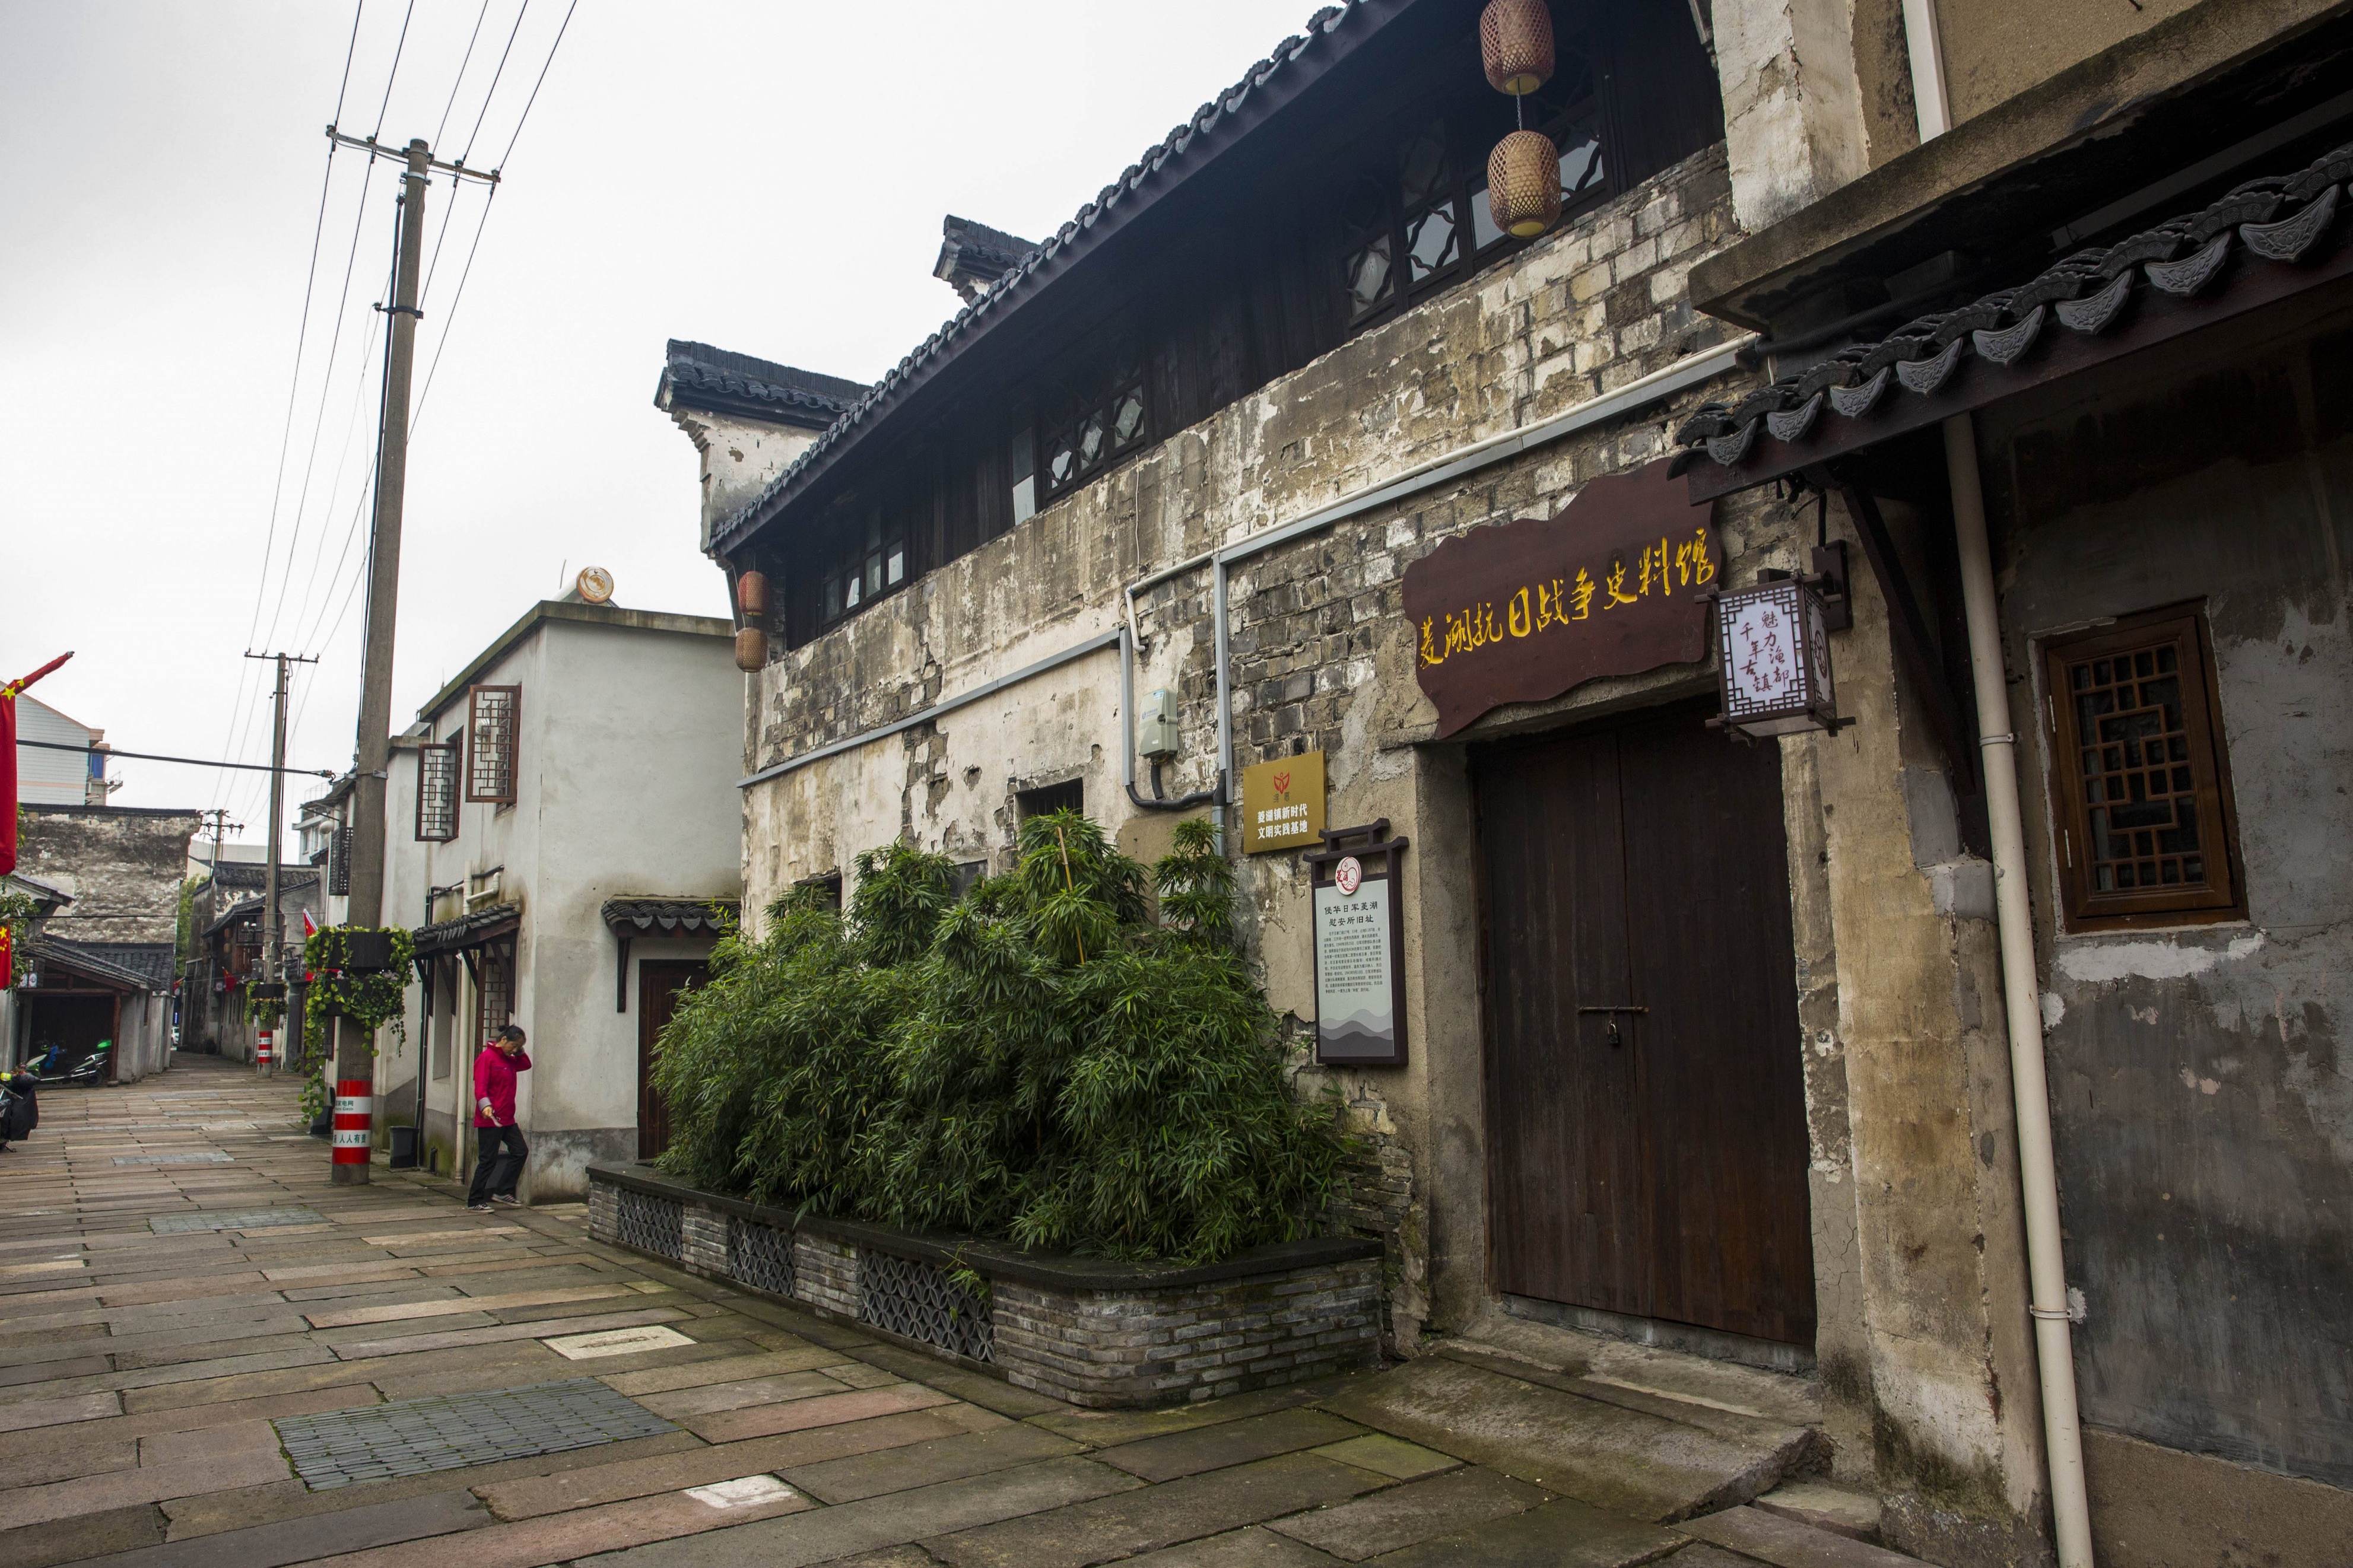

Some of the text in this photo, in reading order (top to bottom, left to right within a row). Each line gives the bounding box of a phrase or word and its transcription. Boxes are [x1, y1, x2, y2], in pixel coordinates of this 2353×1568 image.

[1420, 527, 1715, 669] 菱湖抗日战争史料馆
[1258, 803, 1307, 824] 菱湖镇新时代
[1258, 819, 1307, 839] 文明实践基地
[1324, 901, 1378, 915] 侵华日军菱湖
[1329, 914, 1374, 927] 慰安所旧址
